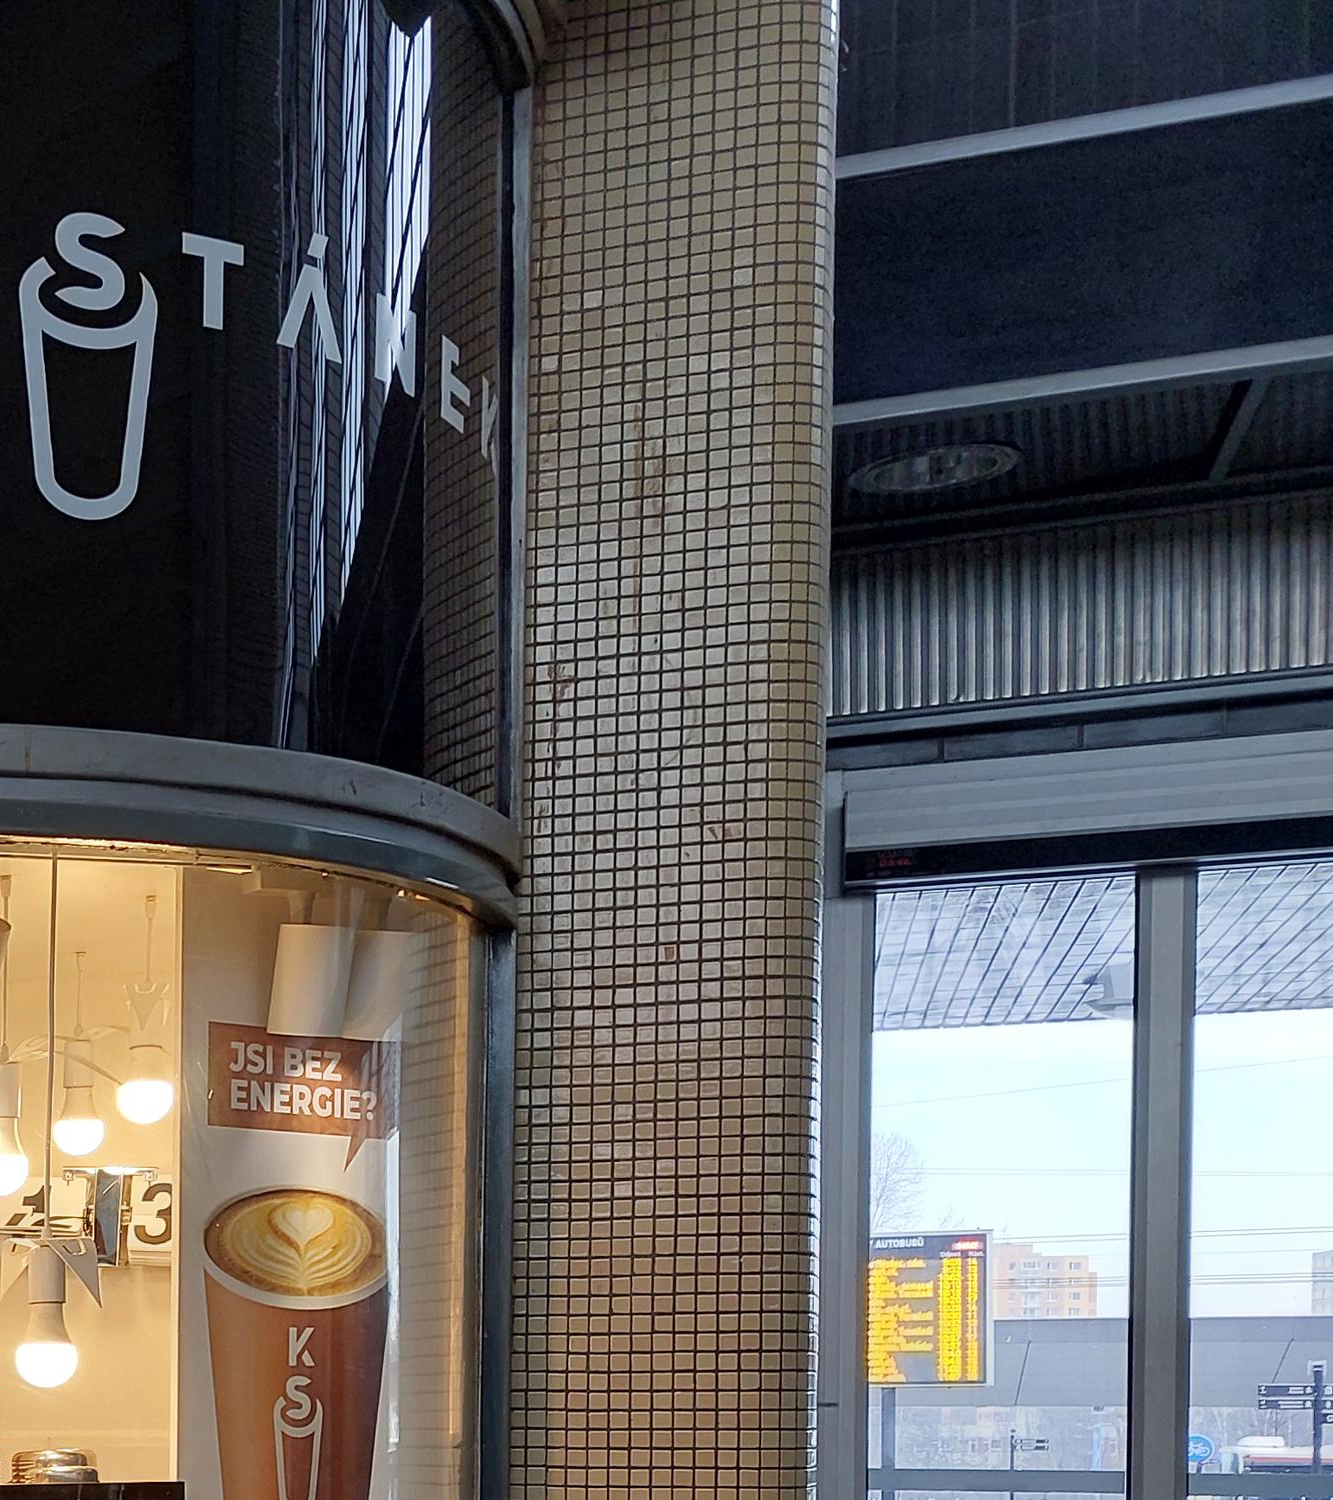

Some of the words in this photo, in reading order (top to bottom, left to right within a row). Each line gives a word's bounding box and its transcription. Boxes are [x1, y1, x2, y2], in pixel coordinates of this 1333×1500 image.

[229, 1041, 273, 1075] JSI
[283, 1047, 342, 1082] BEZ
[230, 1078, 377, 1121] ENERGIE?
[288, 1326, 316, 1368] K
[284, 1376, 312, 1420] S
